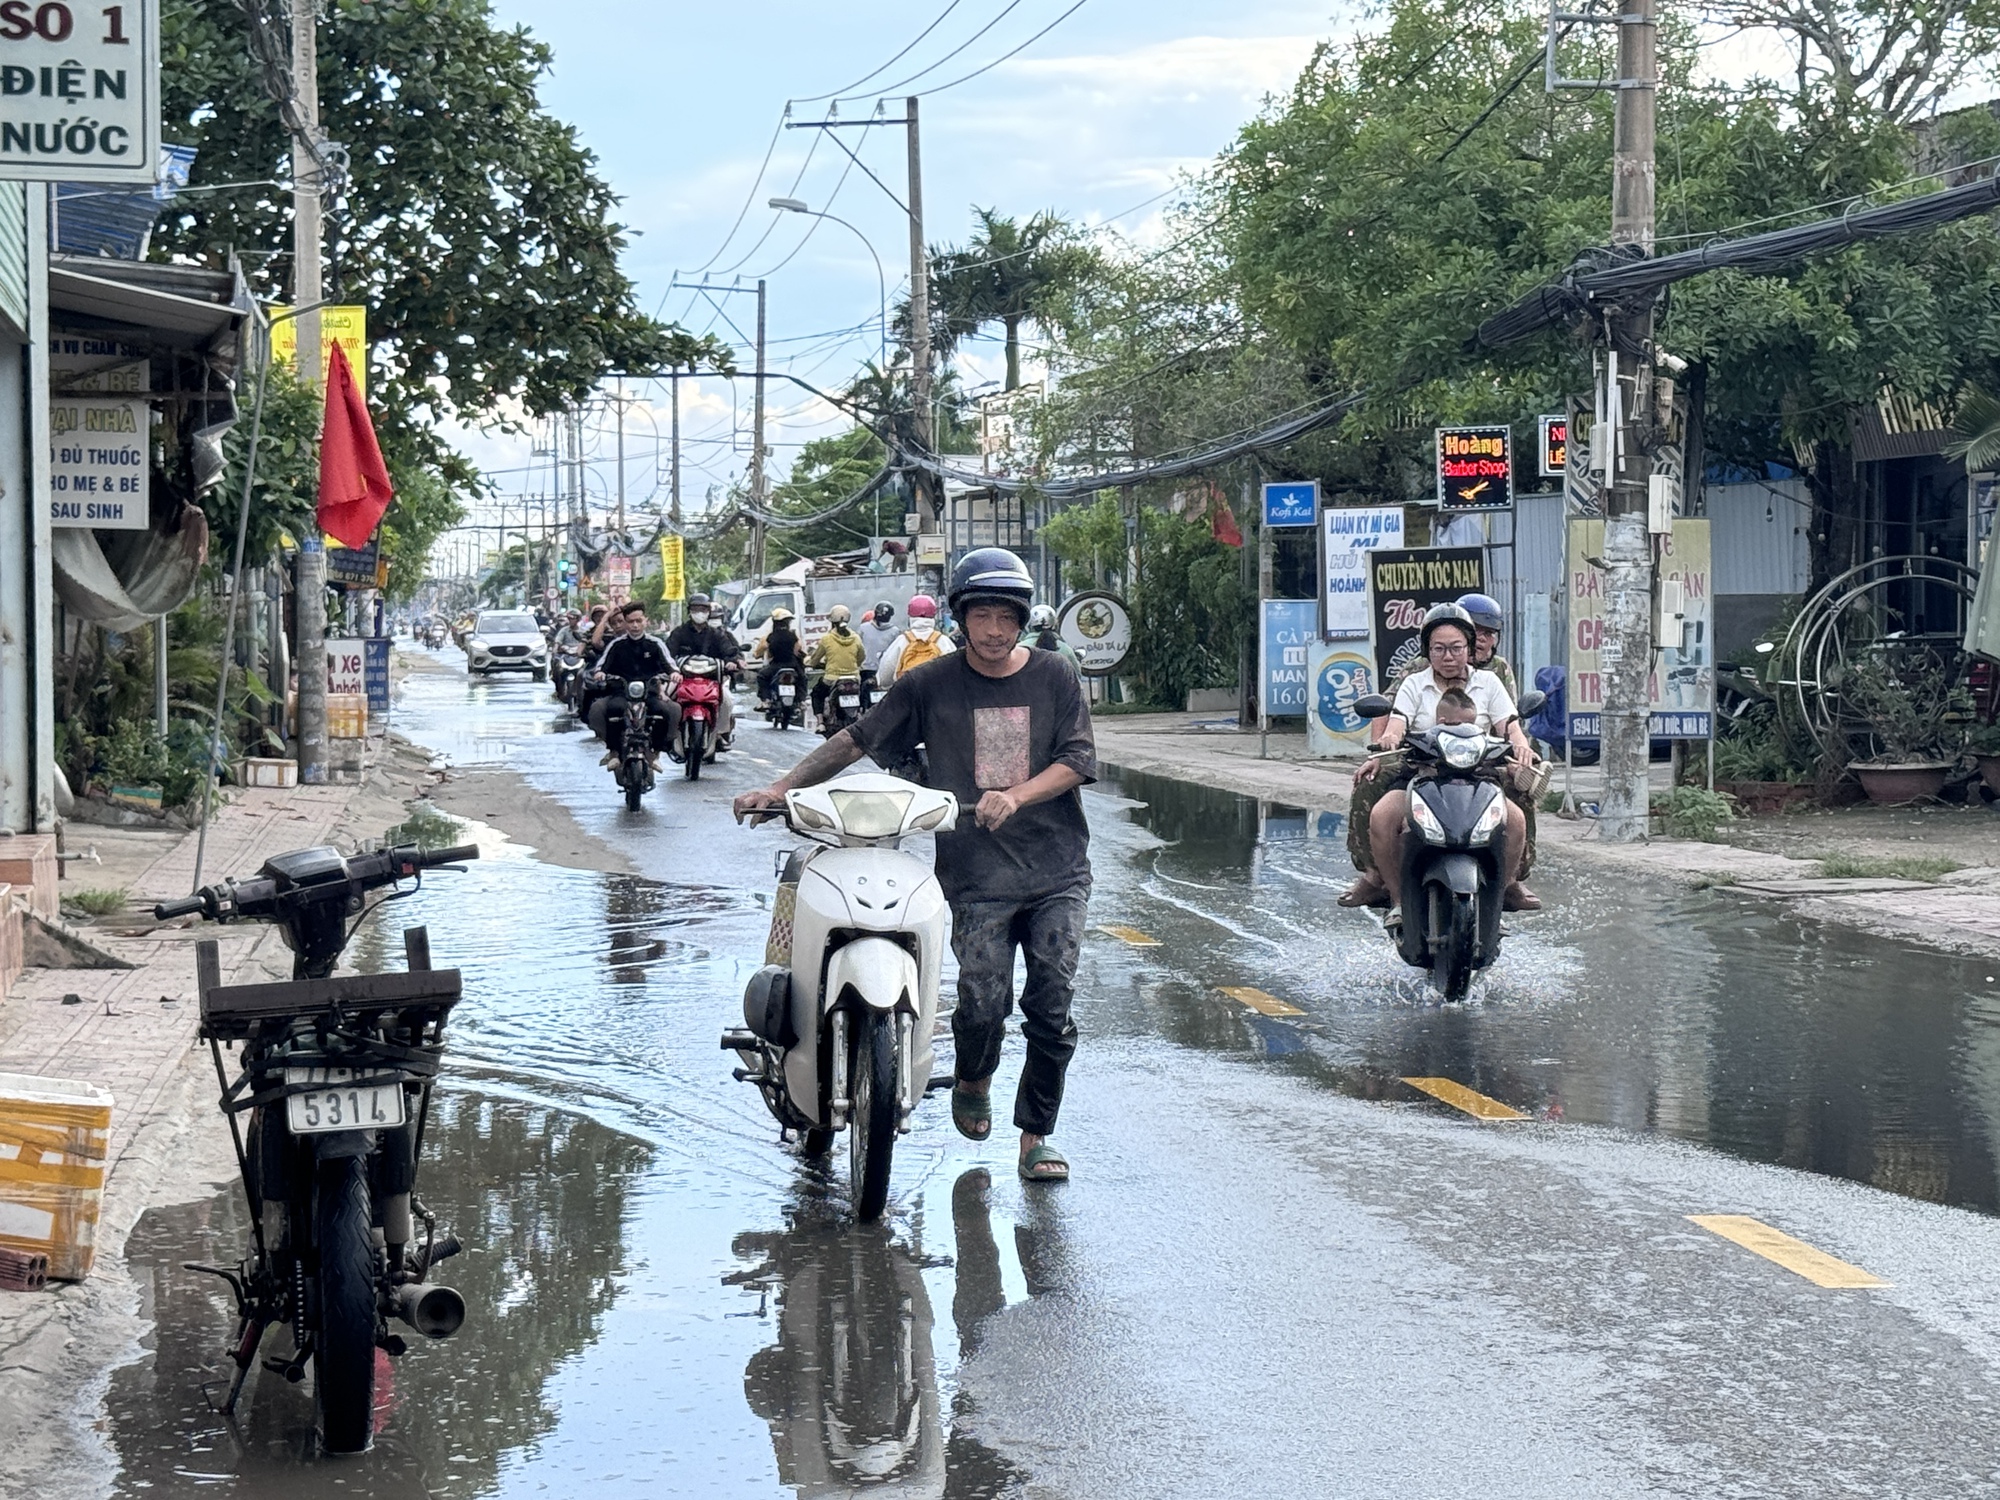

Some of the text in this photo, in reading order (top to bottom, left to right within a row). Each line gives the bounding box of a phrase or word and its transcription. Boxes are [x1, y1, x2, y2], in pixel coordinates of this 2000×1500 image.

[102, 5, 130, 45] 1
[0, 59, 127, 104] ĐIỆN
[1, 116, 129, 156] NƯỚC
[108, 367, 140, 391] BÉ
[86, 404, 137, 433] NHÀ
[60, 442, 82, 464] ĐỦ
[88, 444, 141, 466] THUỐC
[1445, 435, 1503, 457] Hoàng
[1445, 459, 1506, 478] Barber Shop
[73, 476, 97, 495] MẸ
[103, 476, 114, 492] &
[120, 474, 140, 492] BÉ
[51, 502, 123, 519] SAU SINH
[1271, 507, 1312, 519] Kofi Kai
[1371, 510, 1382, 533] MÌ
[1384, 514, 1400, 533] GIA
[1349, 534, 1380, 548] MÌ
[1376, 554, 1425, 592] CHUYÊN
[1427, 553, 1451, 590] TÓC
[1452, 559, 1480, 588] NAM
[1276, 627, 1298, 644] CÀ
[341, 654, 361, 674] xe
[1272, 670, 1306, 683] MAN
[1272, 687, 1306, 705] 16.0
[1578, 673, 1602, 703] TR
[1573, 718, 1591, 735] 1594
[1682, 715, 1698, 734] NHÀ
[1699, 715, 1709, 734] BÈ
[304, 1090, 386, 1126] 5314
